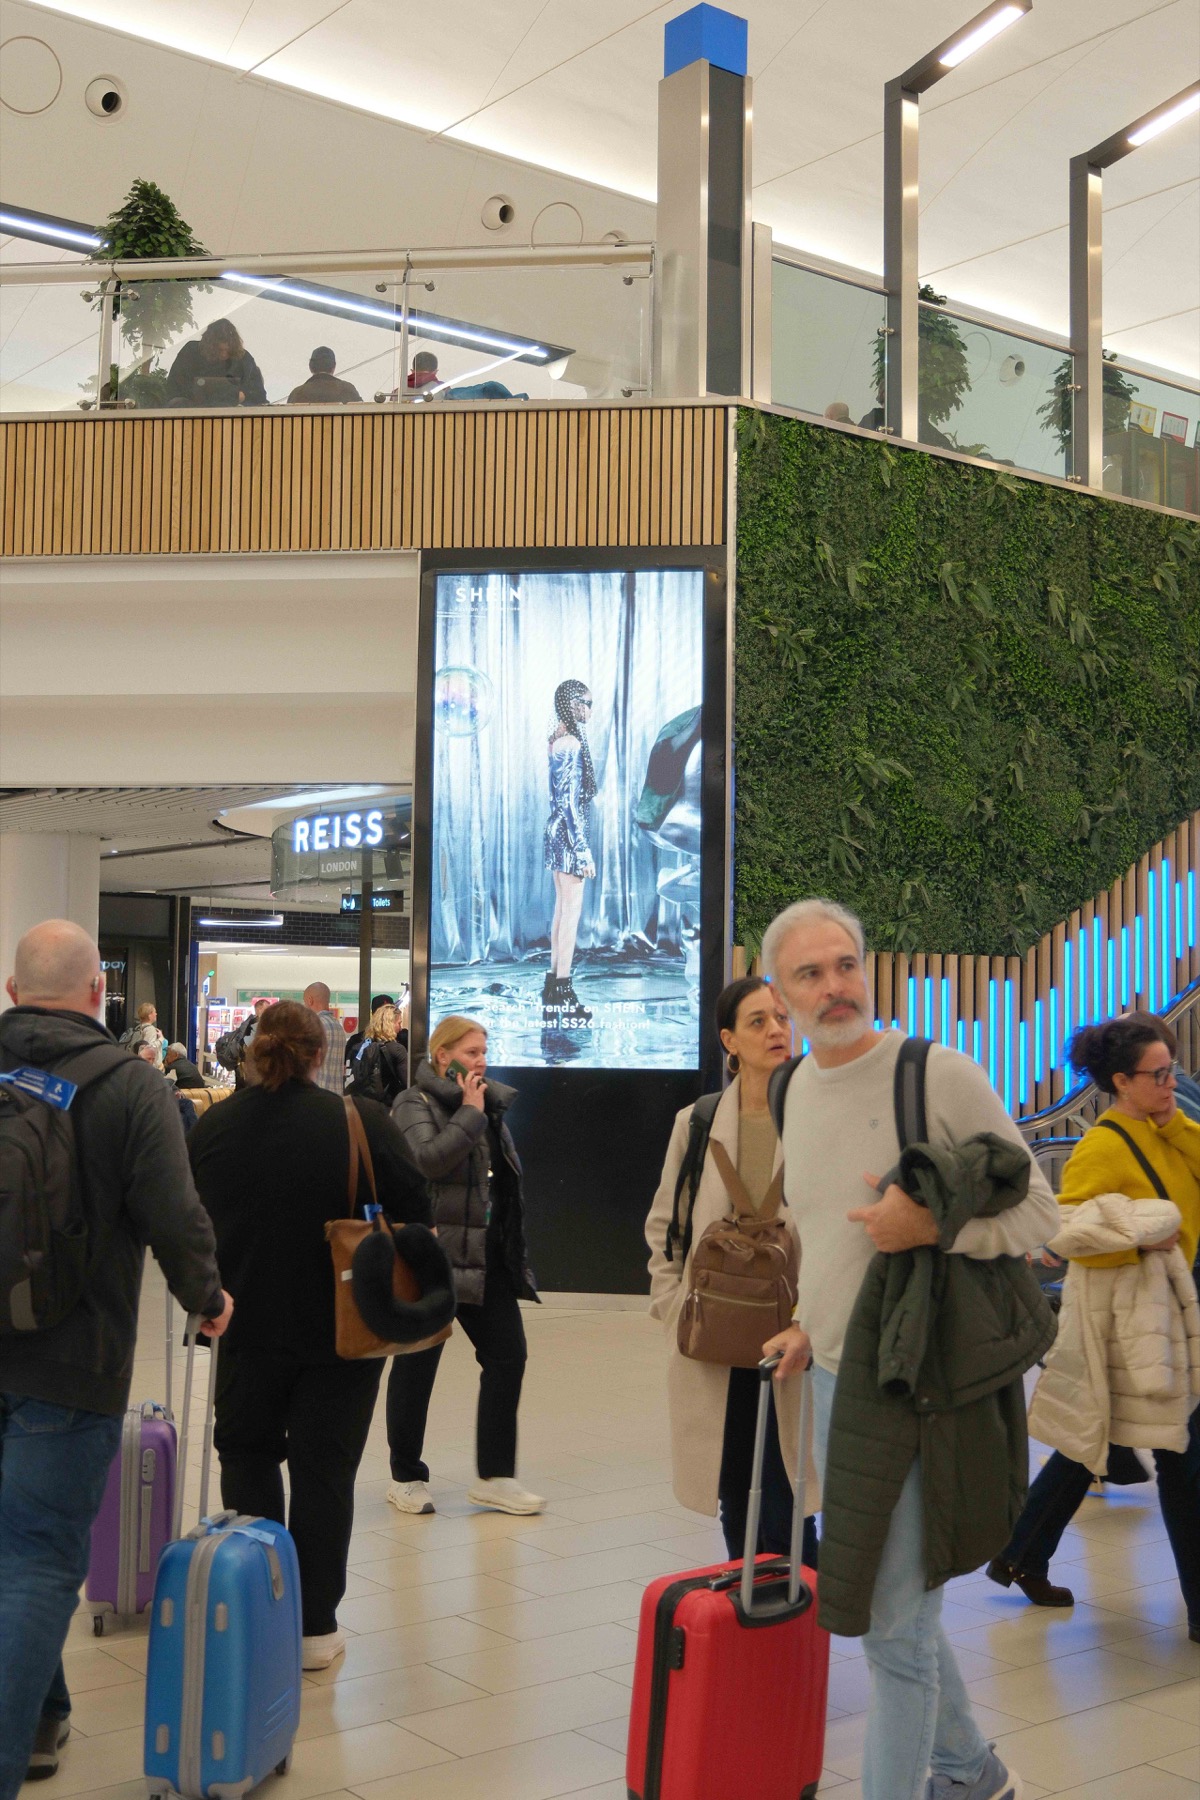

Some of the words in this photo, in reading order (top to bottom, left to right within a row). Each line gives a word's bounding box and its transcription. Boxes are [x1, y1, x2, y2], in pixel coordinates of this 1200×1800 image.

[455, 586, 521, 603] SHEIN
[294, 810, 384, 853] REISS
[321, 860, 358, 873] LONDON
[372, 897, 391, 907] Toilets
[583, 1004, 599, 1013] on
[604, 1001, 646, 1013] SHEIN
[524, 1016, 558, 1028] latest
[561, 1017, 595, 1028] SS26
